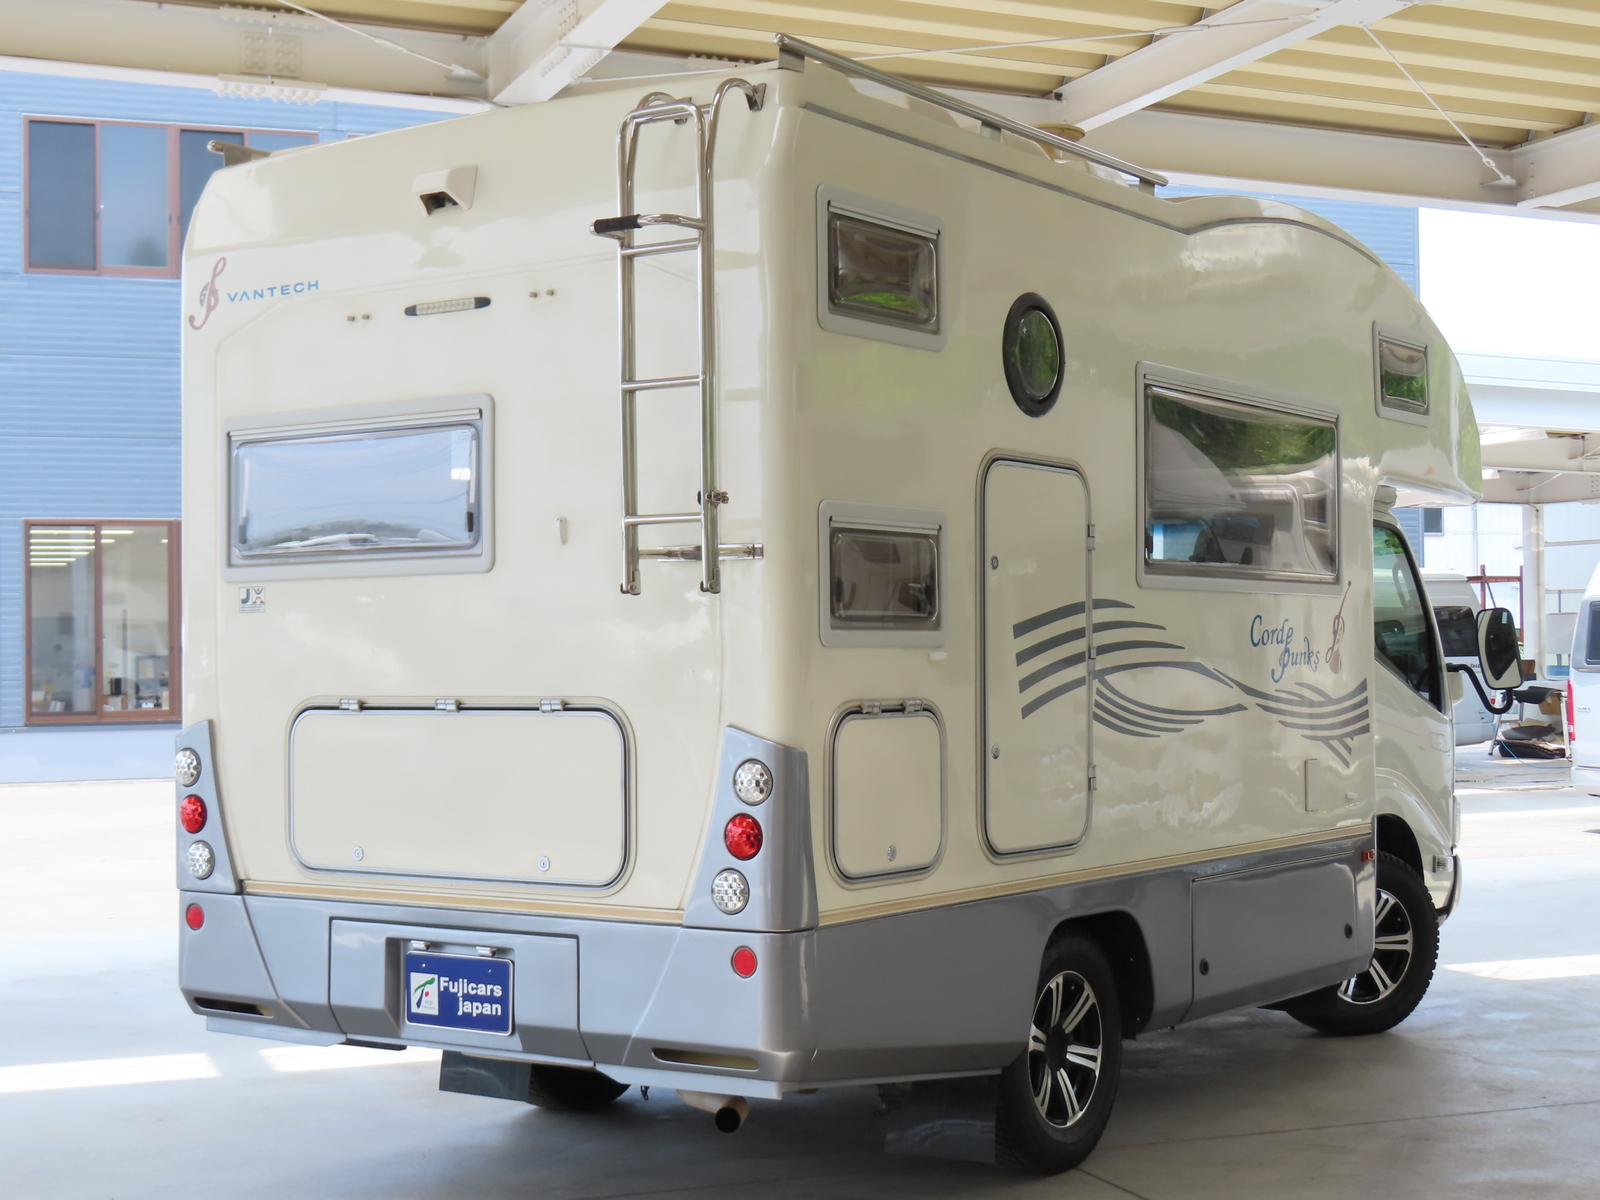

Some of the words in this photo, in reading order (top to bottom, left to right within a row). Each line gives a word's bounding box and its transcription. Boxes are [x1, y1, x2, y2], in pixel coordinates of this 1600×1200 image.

[227, 280, 319, 302] VANTECH
[1250, 614, 1294, 647] Corde
[439, 976, 503, 997] Fujicars
[457, 997, 502, 1017] japan
